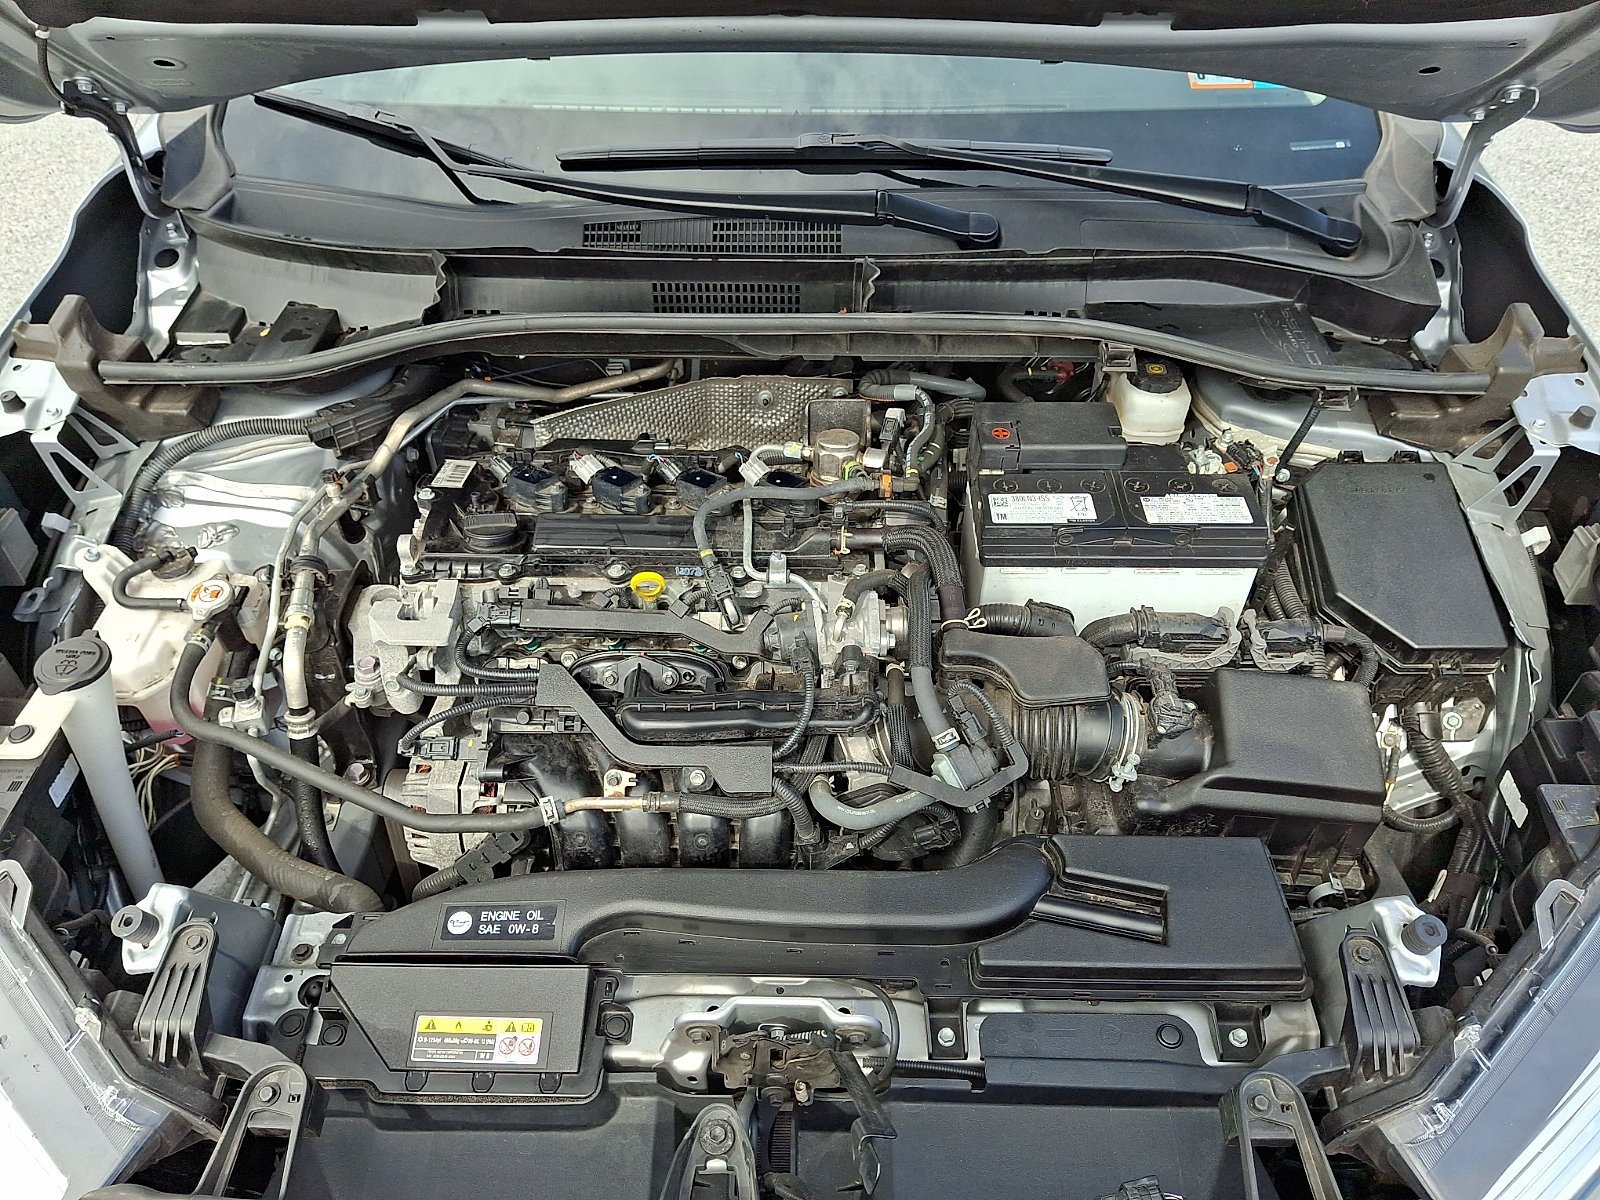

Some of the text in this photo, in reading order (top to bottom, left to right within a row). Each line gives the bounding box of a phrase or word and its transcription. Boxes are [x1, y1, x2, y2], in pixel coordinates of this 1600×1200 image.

[480, 910, 544, 922] ENGINE OIL
[478, 924, 539, 935] SAE 0W-8
